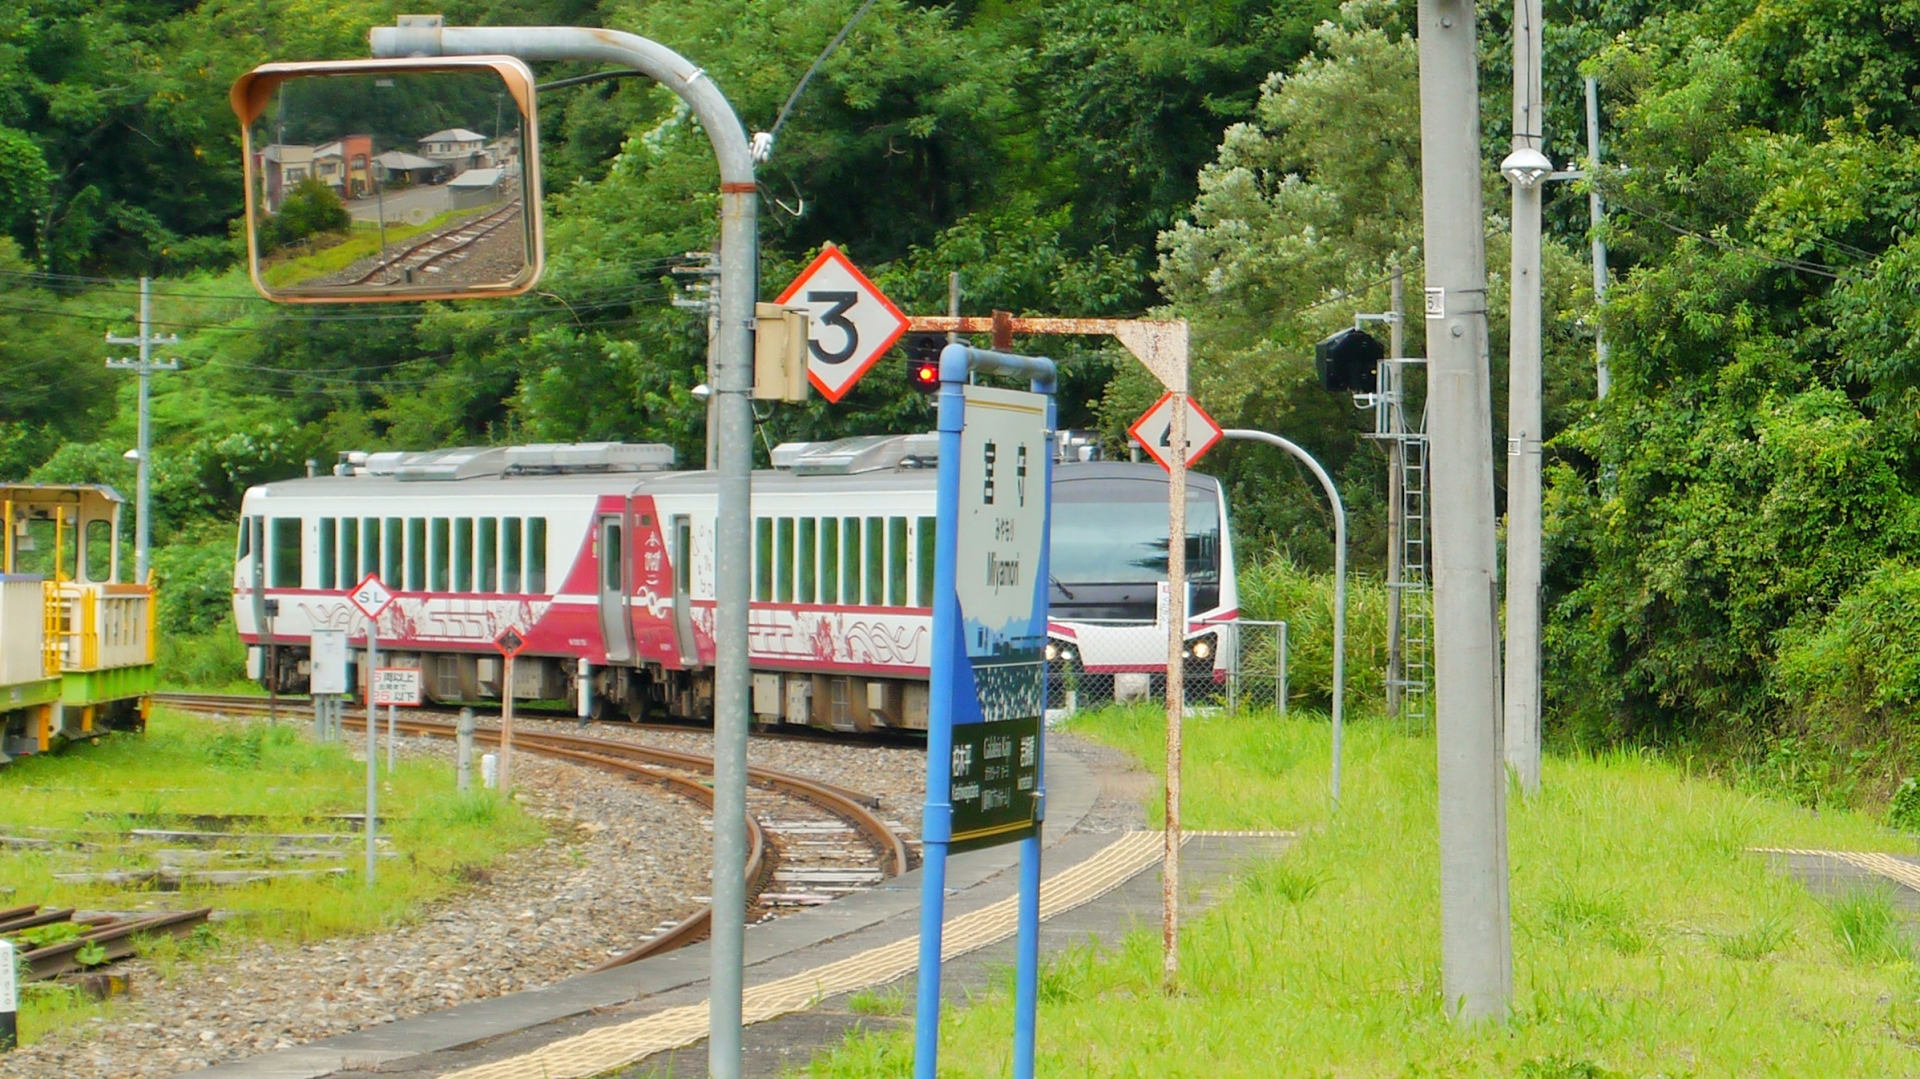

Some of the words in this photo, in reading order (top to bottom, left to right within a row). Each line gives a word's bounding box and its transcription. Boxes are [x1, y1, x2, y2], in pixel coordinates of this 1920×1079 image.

[807, 291, 858, 365] 3
[986, 551, 1020, 596] Miyamori
[359, 591, 384, 603] SL
